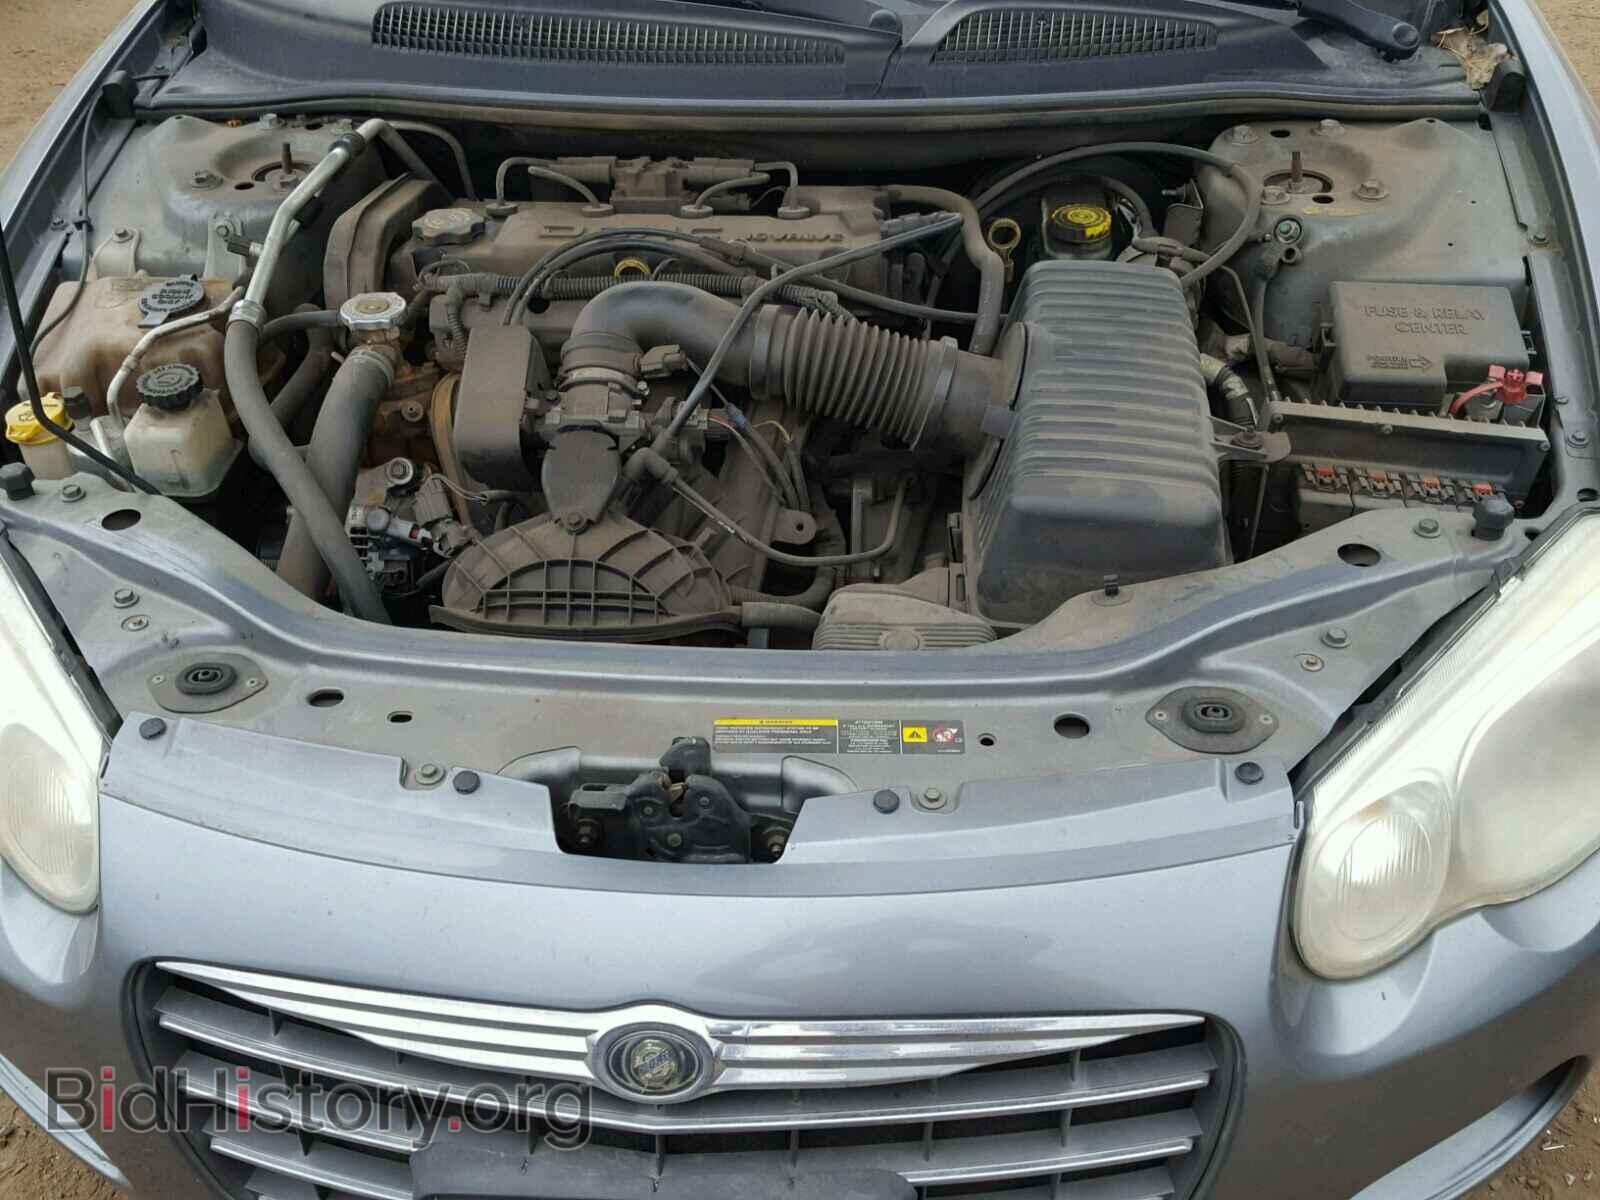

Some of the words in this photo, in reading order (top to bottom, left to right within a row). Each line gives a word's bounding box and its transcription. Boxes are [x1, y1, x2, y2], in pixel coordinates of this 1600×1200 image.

[1361, 304, 1409, 319] FUSE
[1414, 306, 1427, 319] &
[1431, 306, 1486, 321] RELAY
[1394, 321, 1470, 336] CENTER
